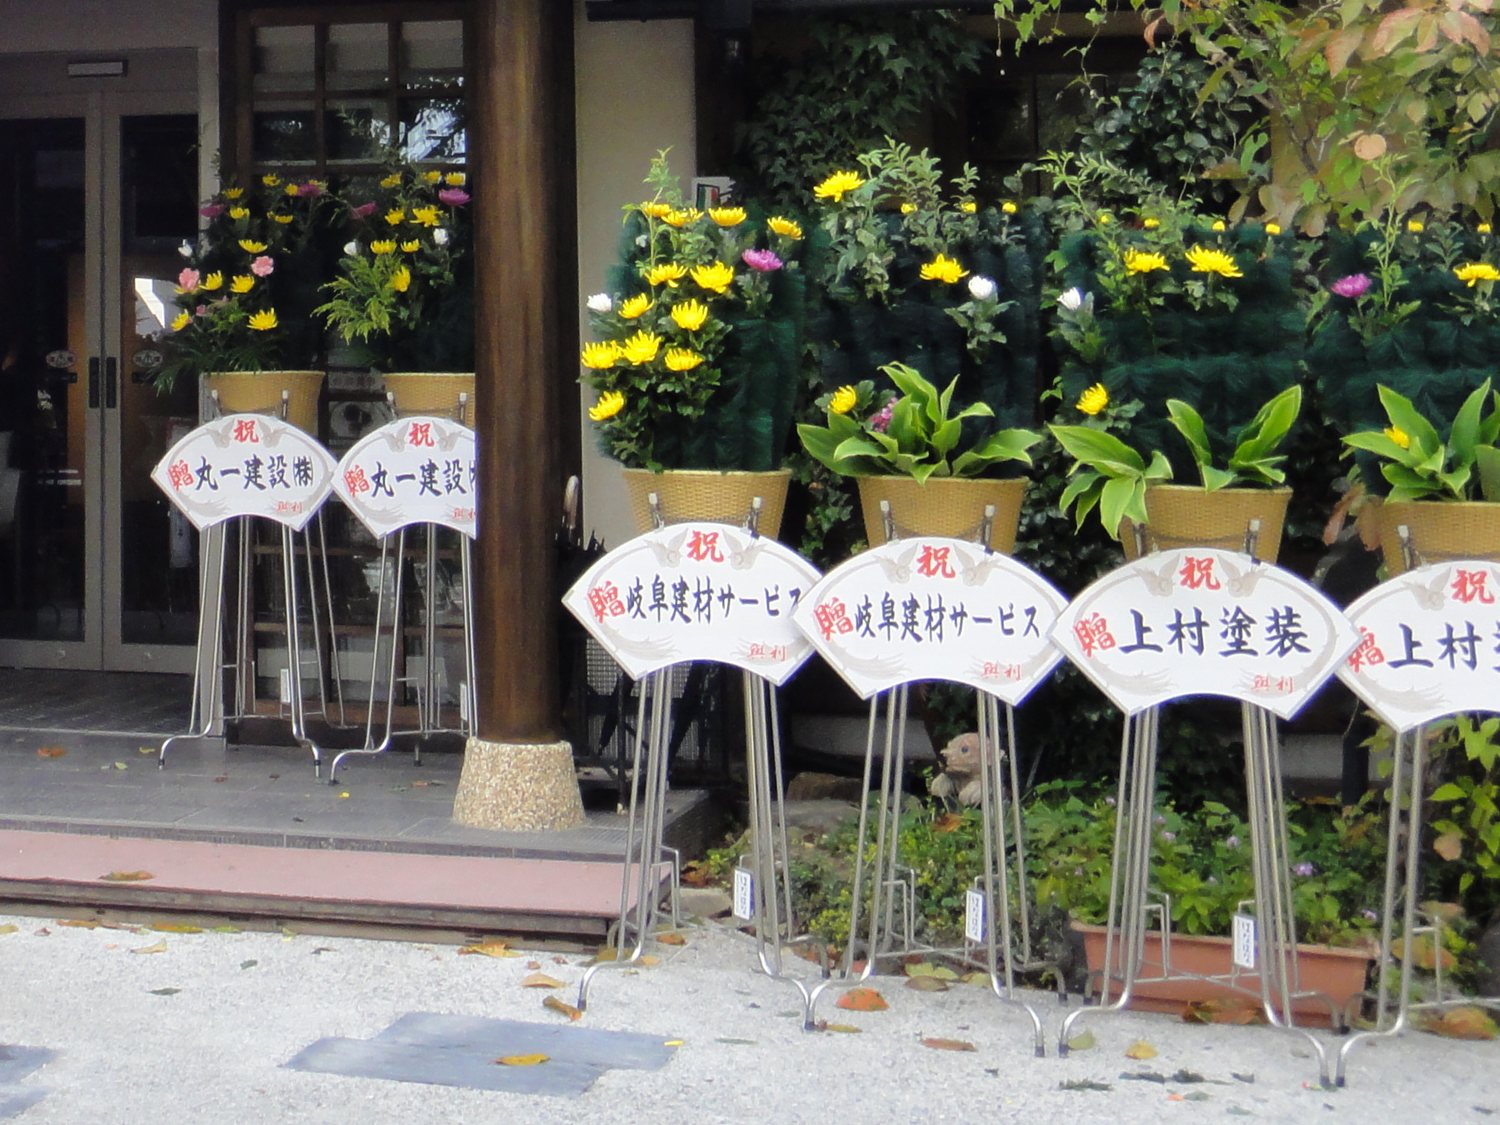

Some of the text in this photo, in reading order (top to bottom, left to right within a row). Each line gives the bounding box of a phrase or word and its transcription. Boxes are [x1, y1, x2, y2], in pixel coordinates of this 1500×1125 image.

[234, 420, 259, 443] 祝
[409, 423, 434, 447] 祝
[687, 530, 724, 563] 祝
[917, 545, 956, 578] 祝
[1179, 556, 1221, 590] 祝
[1451, 569, 1495, 604] 祝
[587, 580, 625, 624] 贈
[813, 597, 854, 642] 贈
[855, 591, 1041, 643] 岐阜建材サービス
[1074, 612, 1116, 658] 贈
[1118, 605, 1312, 658] 上村塗装
[1387, 620, 1500, 673] 上村
